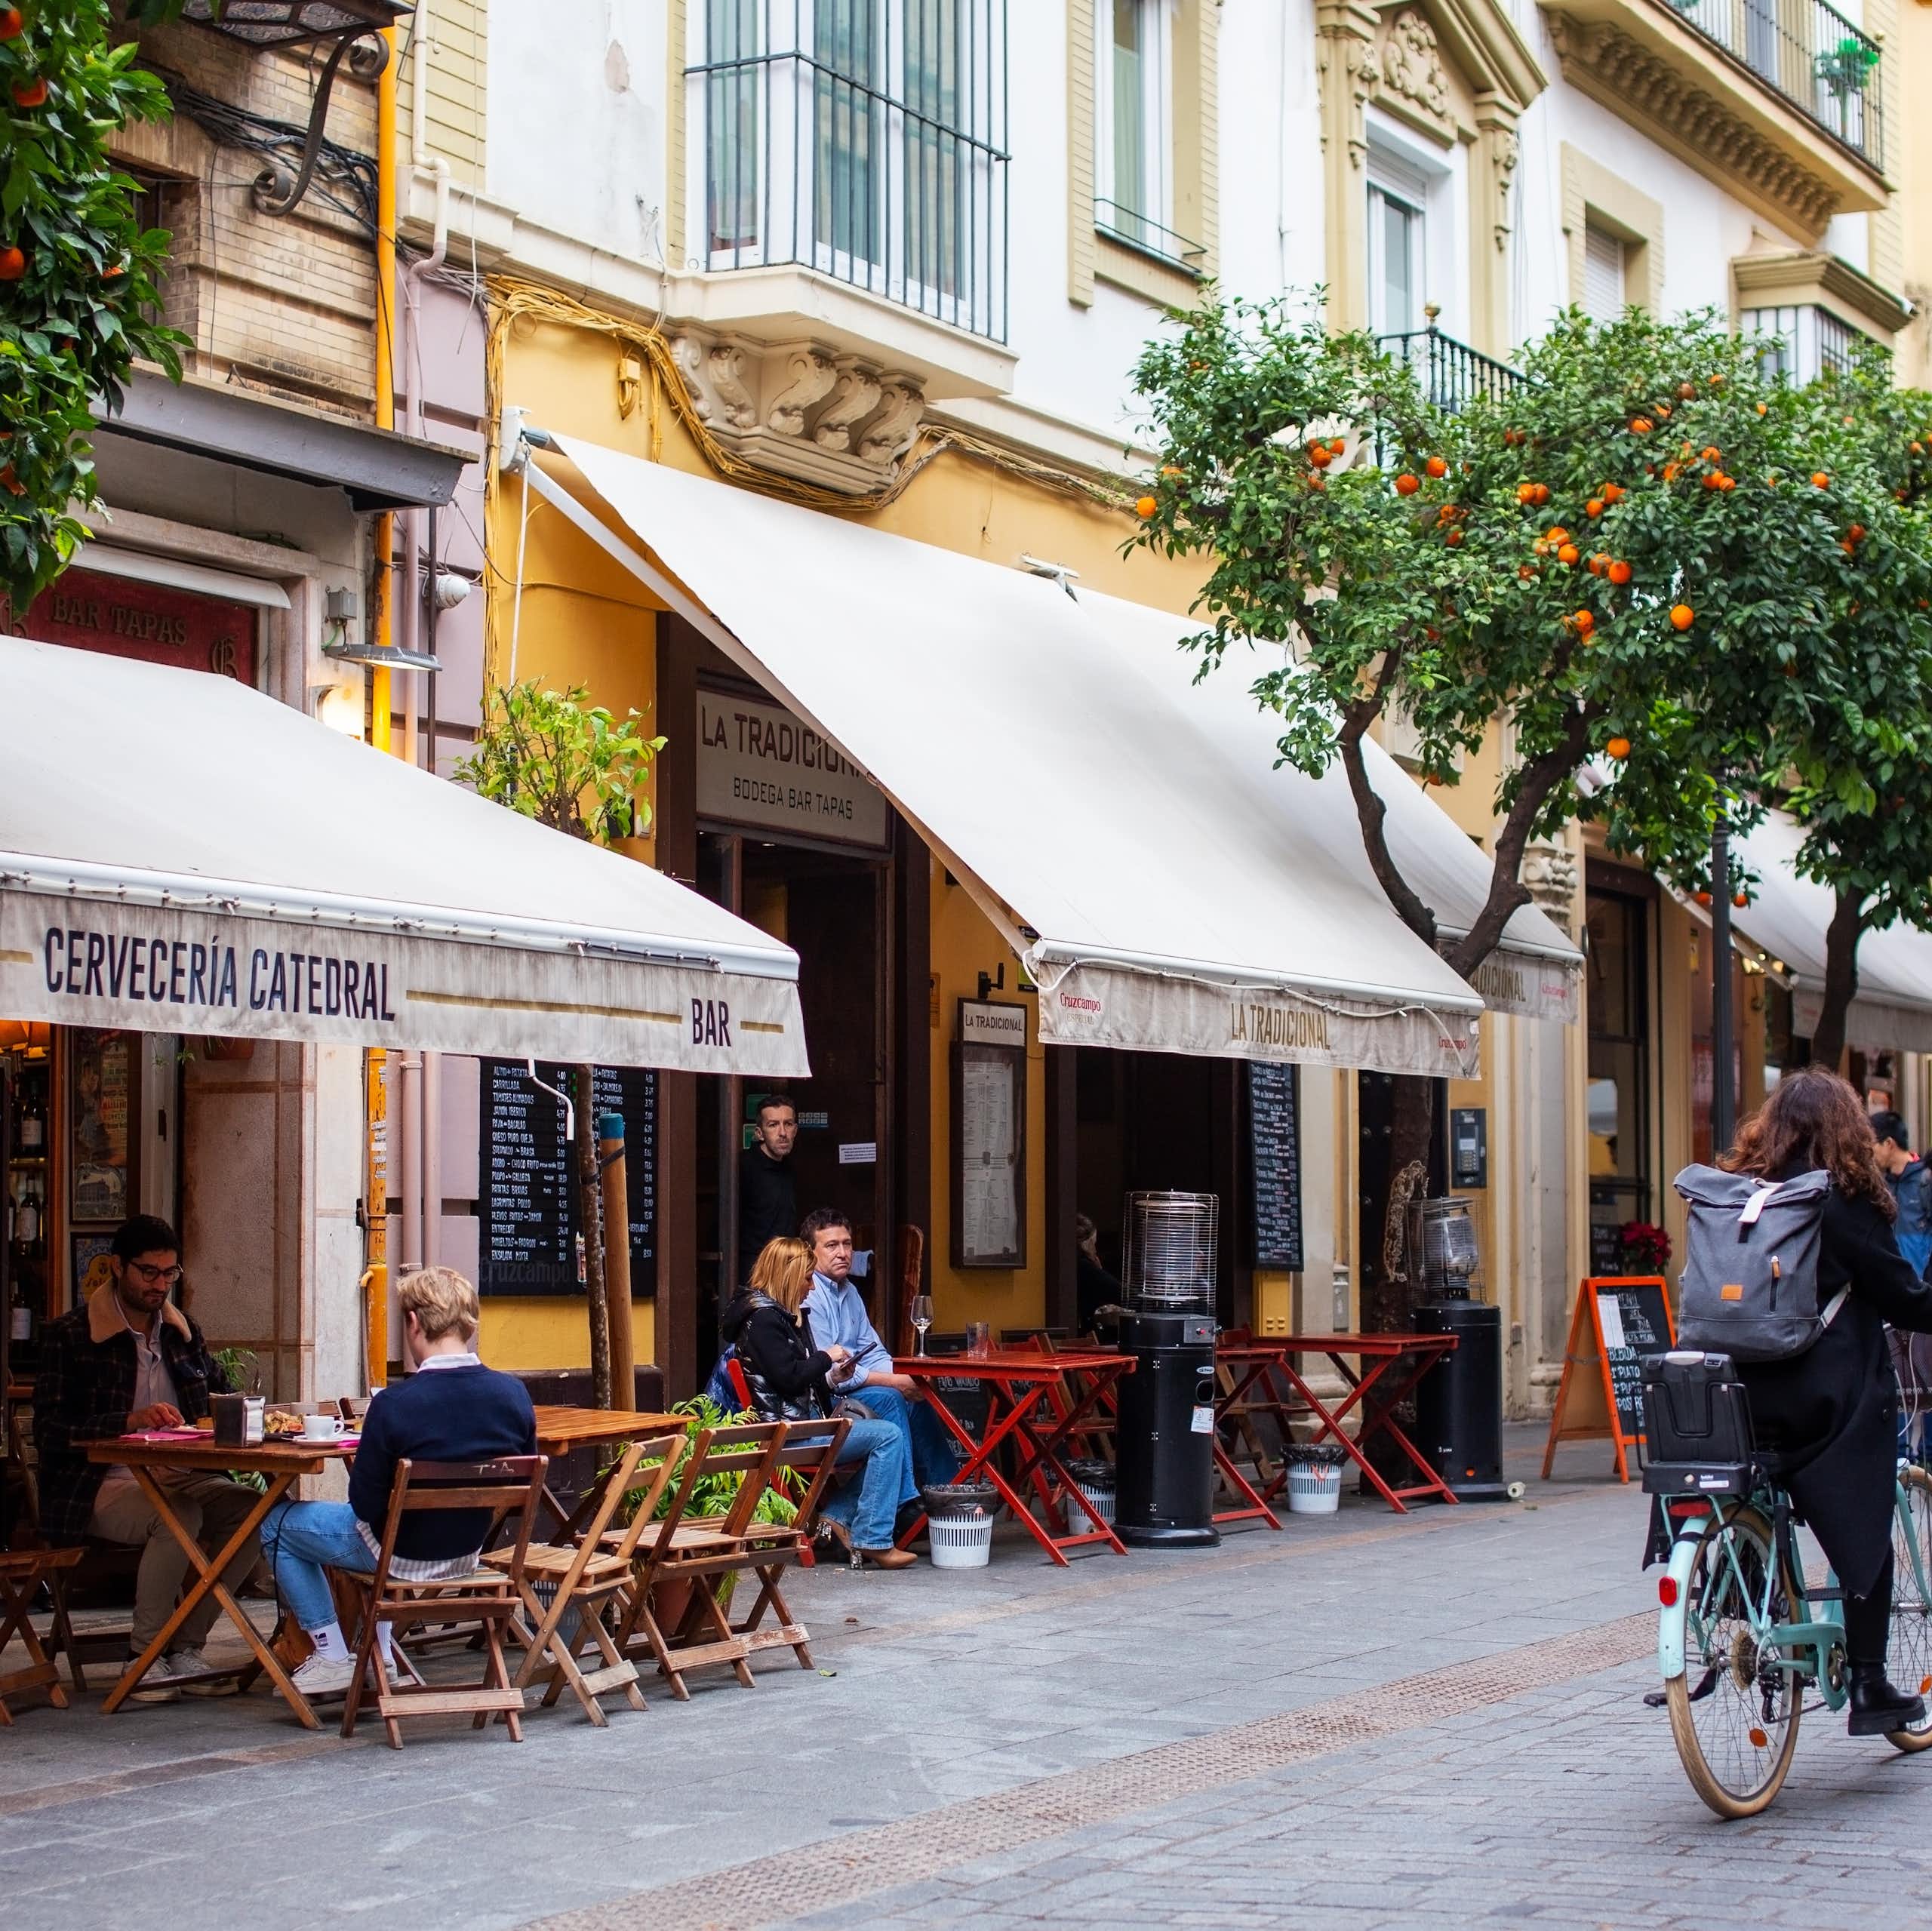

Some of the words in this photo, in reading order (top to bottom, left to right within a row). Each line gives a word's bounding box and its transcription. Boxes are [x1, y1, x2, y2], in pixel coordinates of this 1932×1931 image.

[51, 595, 102, 629] BAR
[112, 604, 188, 647] TAPAS
[702, 705, 728, 749] LA
[734, 712, 858, 778] TRADICION
[734, 776, 784, 808] BODEGA
[789, 789, 812, 811] BAR
[816, 794, 853, 820] TAPAS
[45, 927, 237, 1007] CERVECERÍA
[249, 948, 395, 1022] CATEDRAL
[691, 998, 732, 1047] BAR
[965, 1014, 974, 1027] LA
[976, 1016, 1023, 1032] TRADICIONAL
[1060, 992, 1101, 1013] Cruzcampo
[1232, 1003, 1247, 1041] LA
[1249, 1004, 1331, 1050] TRADICIONAL
[492, 1184, 509, 1194] PATATAS
[1617, 1366, 1641, 1378] PLATO
